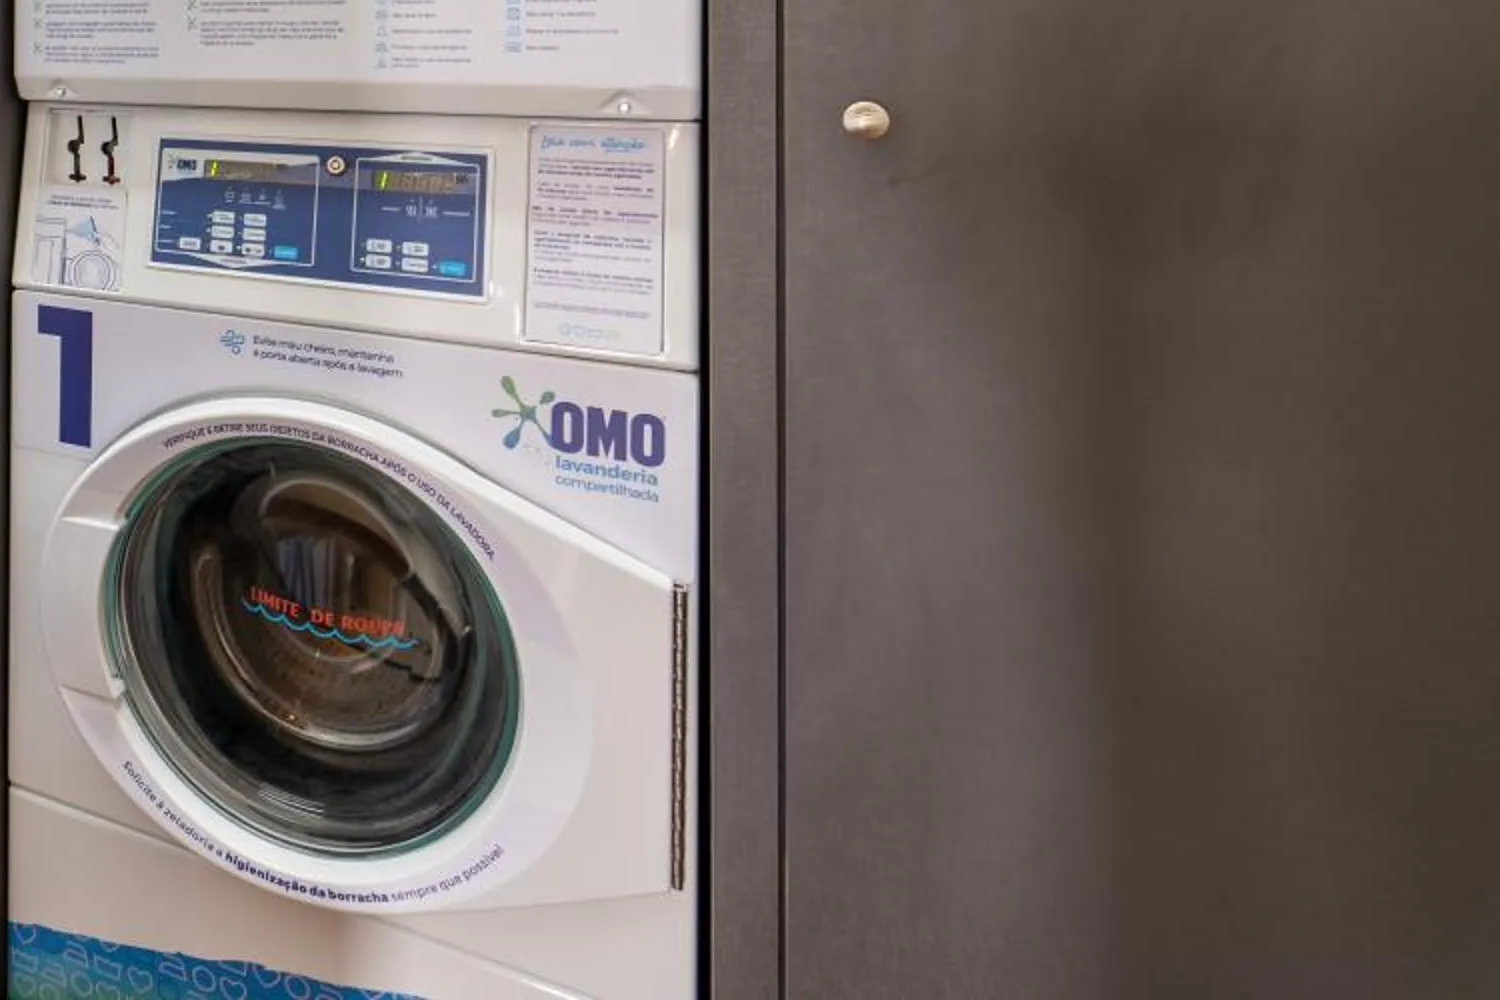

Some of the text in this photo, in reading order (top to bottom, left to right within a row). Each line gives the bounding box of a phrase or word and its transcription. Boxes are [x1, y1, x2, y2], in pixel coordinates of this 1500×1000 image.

[37, 303, 93, 449] 1
[551, 401, 666, 467] OMO
[554, 474, 660, 504] compartilhada
[555, 454, 659, 487] lavanderia
[407, 472, 417, 484] O
[416, 477, 437, 499] USO
[437, 492, 452, 511] DA
[450, 506, 496, 561] LAVADORA
[250, 585, 300, 618] LIMITE
[310, 607, 336, 626] DE
[121, 759, 158, 803] Solicite
[163, 805, 215, 851] zeladoria
[225, 850, 307, 895] higienização
[309, 884, 327, 899] da
[327, 887, 390, 904] borracha
[390, 884, 438, 903] sempre
[438, 874, 463, 893] que
[461, 842, 506, 883] possível
